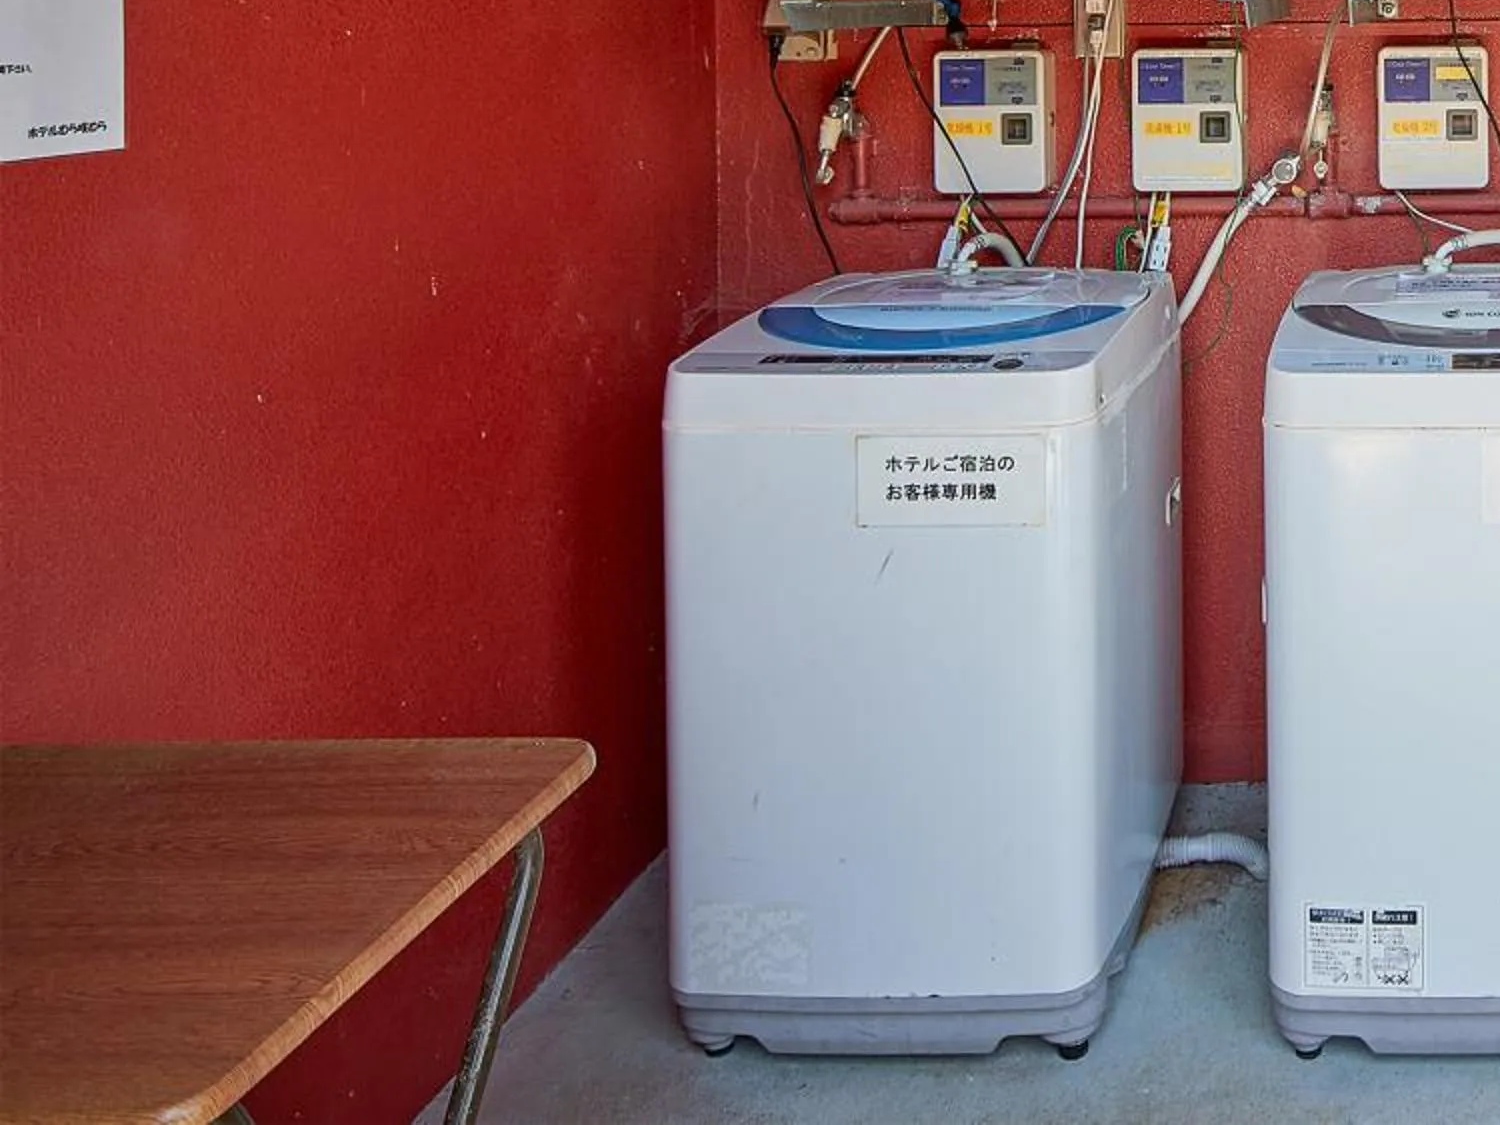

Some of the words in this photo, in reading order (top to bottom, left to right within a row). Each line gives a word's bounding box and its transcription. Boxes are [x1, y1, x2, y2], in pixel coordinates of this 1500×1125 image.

[885, 455, 1015, 473] ホテルご宿泊の
[886, 483, 997, 501] お客様専用機
